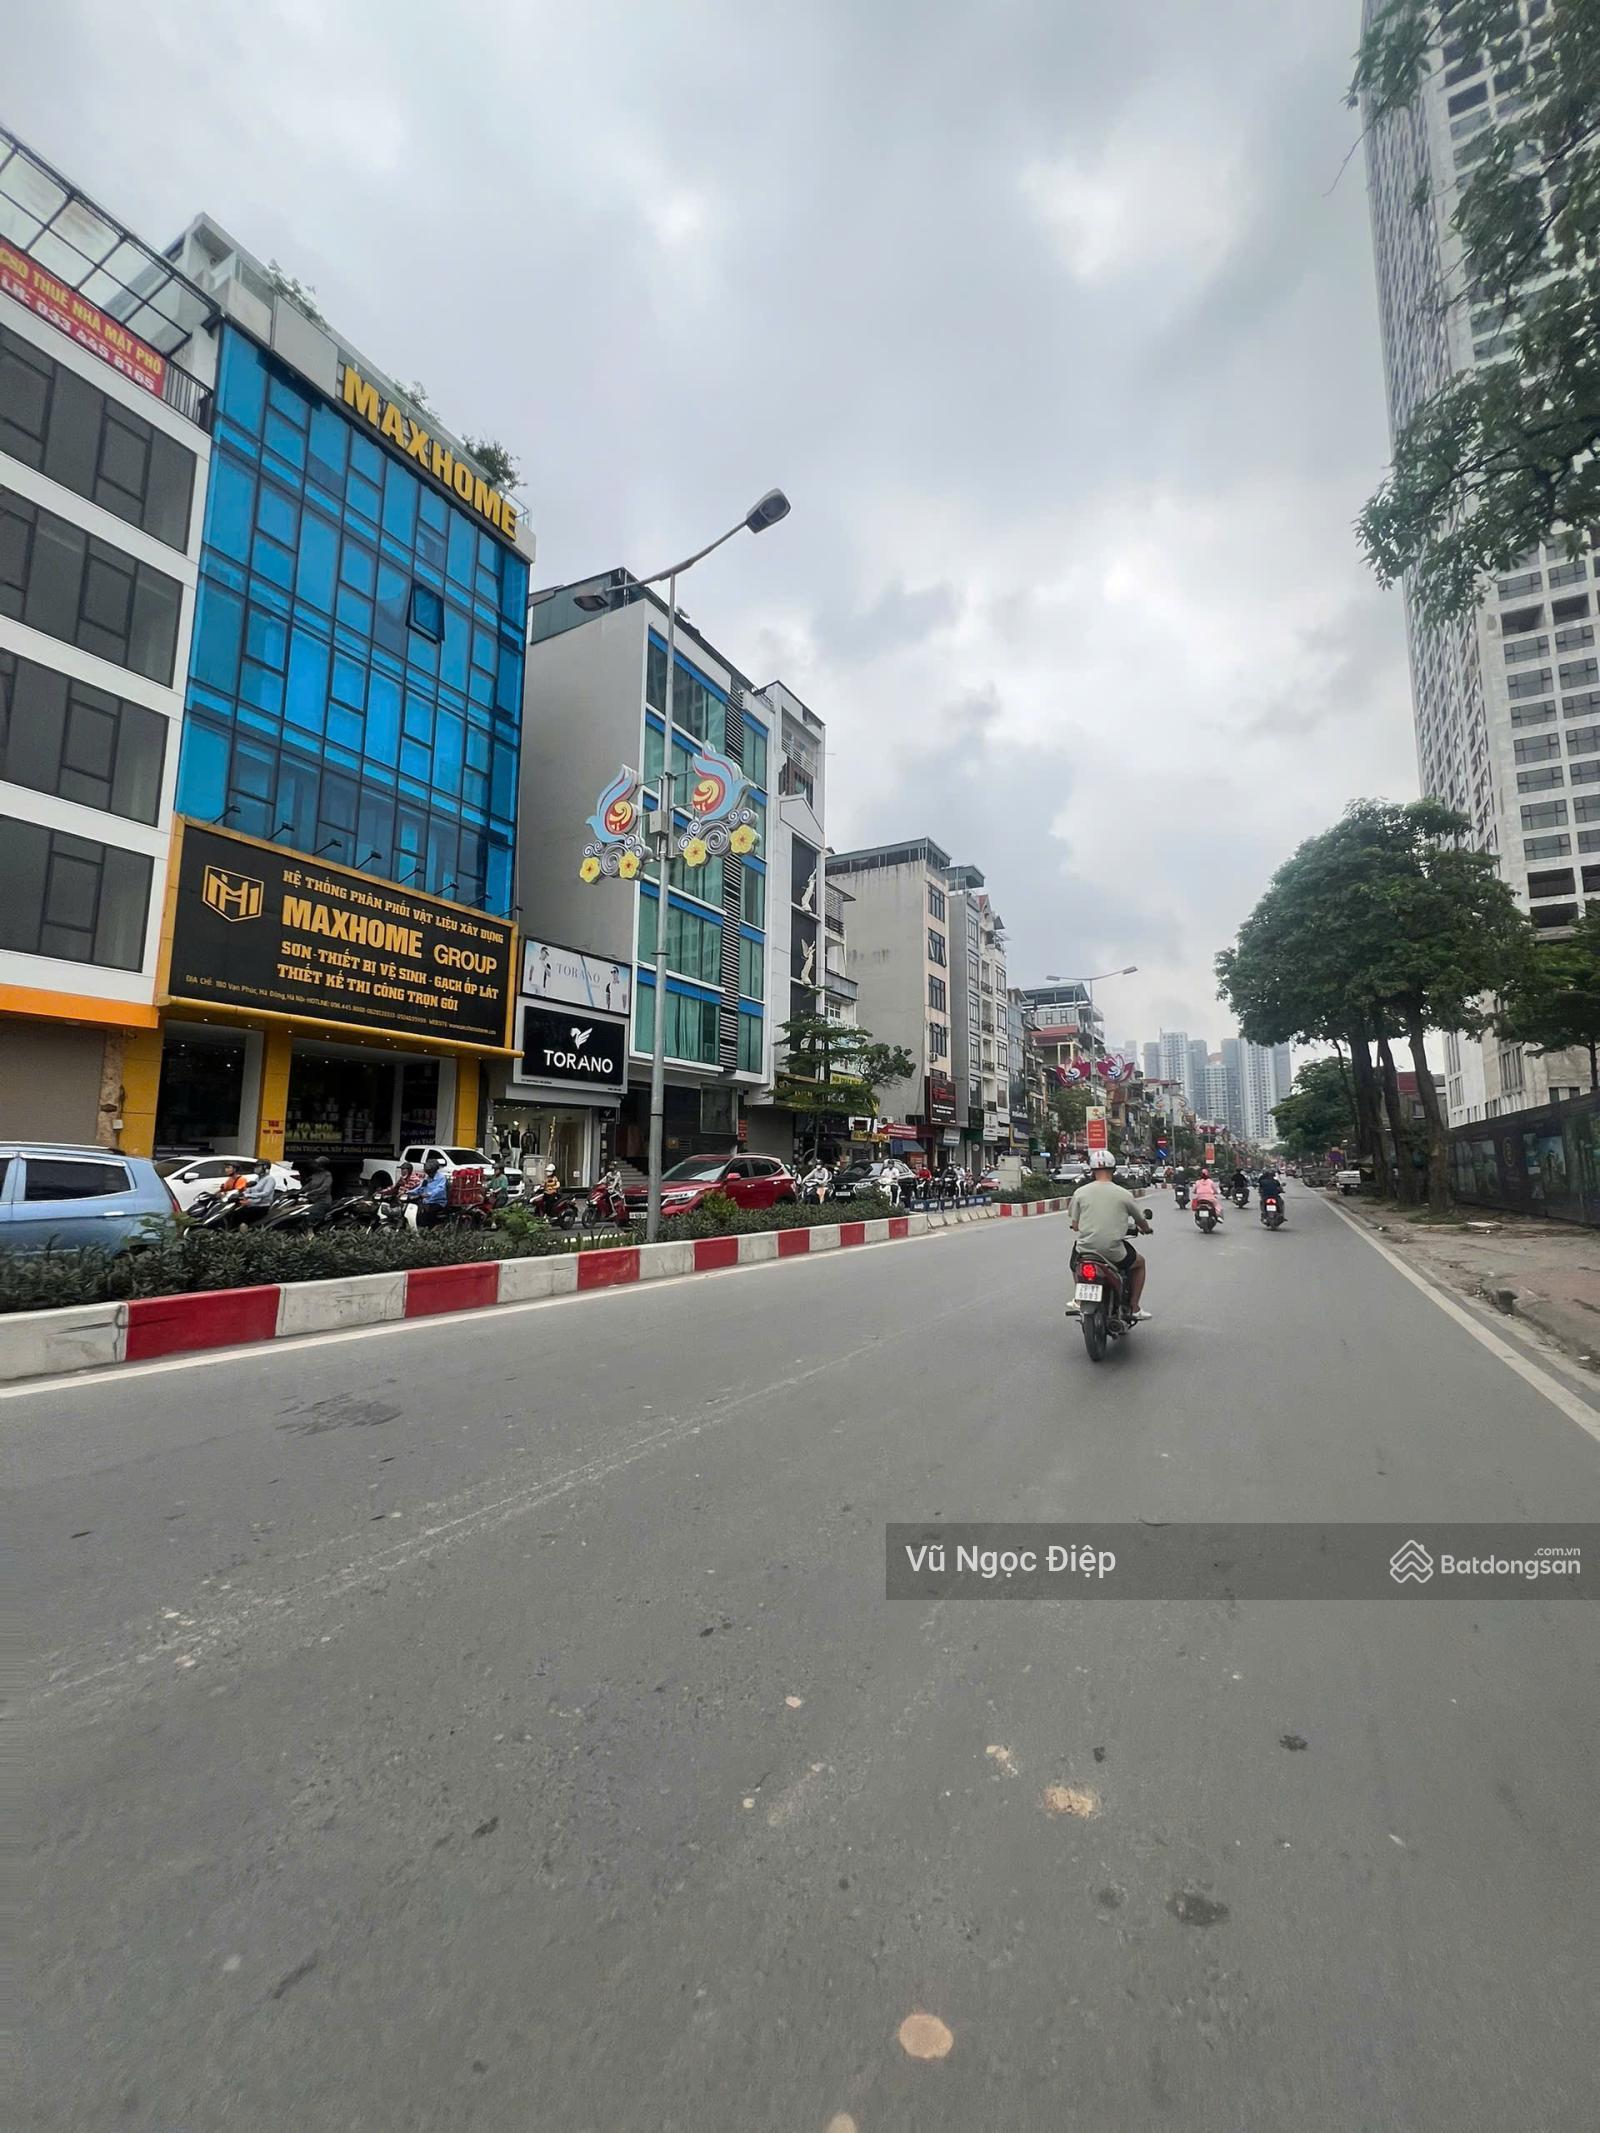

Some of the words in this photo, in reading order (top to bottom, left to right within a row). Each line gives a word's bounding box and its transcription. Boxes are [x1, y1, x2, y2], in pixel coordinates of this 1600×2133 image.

[344, 366, 517, 541] MAXHOME
[282, 870, 302, 888] HỆ
[305, 876, 347, 900] THỐNG
[350, 890, 383, 910] PHÂN
[384, 900, 410, 917] PHỐI
[413, 908, 434, 925] VẬT
[436, 915, 458, 932] LIỆU
[460, 922, 479, 937] XÂY
[480, 929, 504, 944] DỰNG
[282, 895, 423, 959] MAXHOME
[433, 944, 498, 975] GROUP
[277, 963, 322, 985] THIẾT
[325, 970, 345, 989] KẾ
[347, 978, 371, 995] THI
[373, 982, 405, 1001] CÔNG
[407, 990, 438, 1008] TRỌN
[441, 995, 458, 1011] GÓI
[281, 941, 313, 960] SƠN
[318, 948, 361, 970] THIẾT
[362, 959, 377, 976] BỊ
[380, 962, 397, 980] VỆ
[399, 968, 427, 985] SINH
[434, 975, 462, 992] GẠCH
[464, 977, 478, 995] ỐP
[479, 984, 499, 1000] LÁT
[543, 1049, 613, 1074] TORANO
